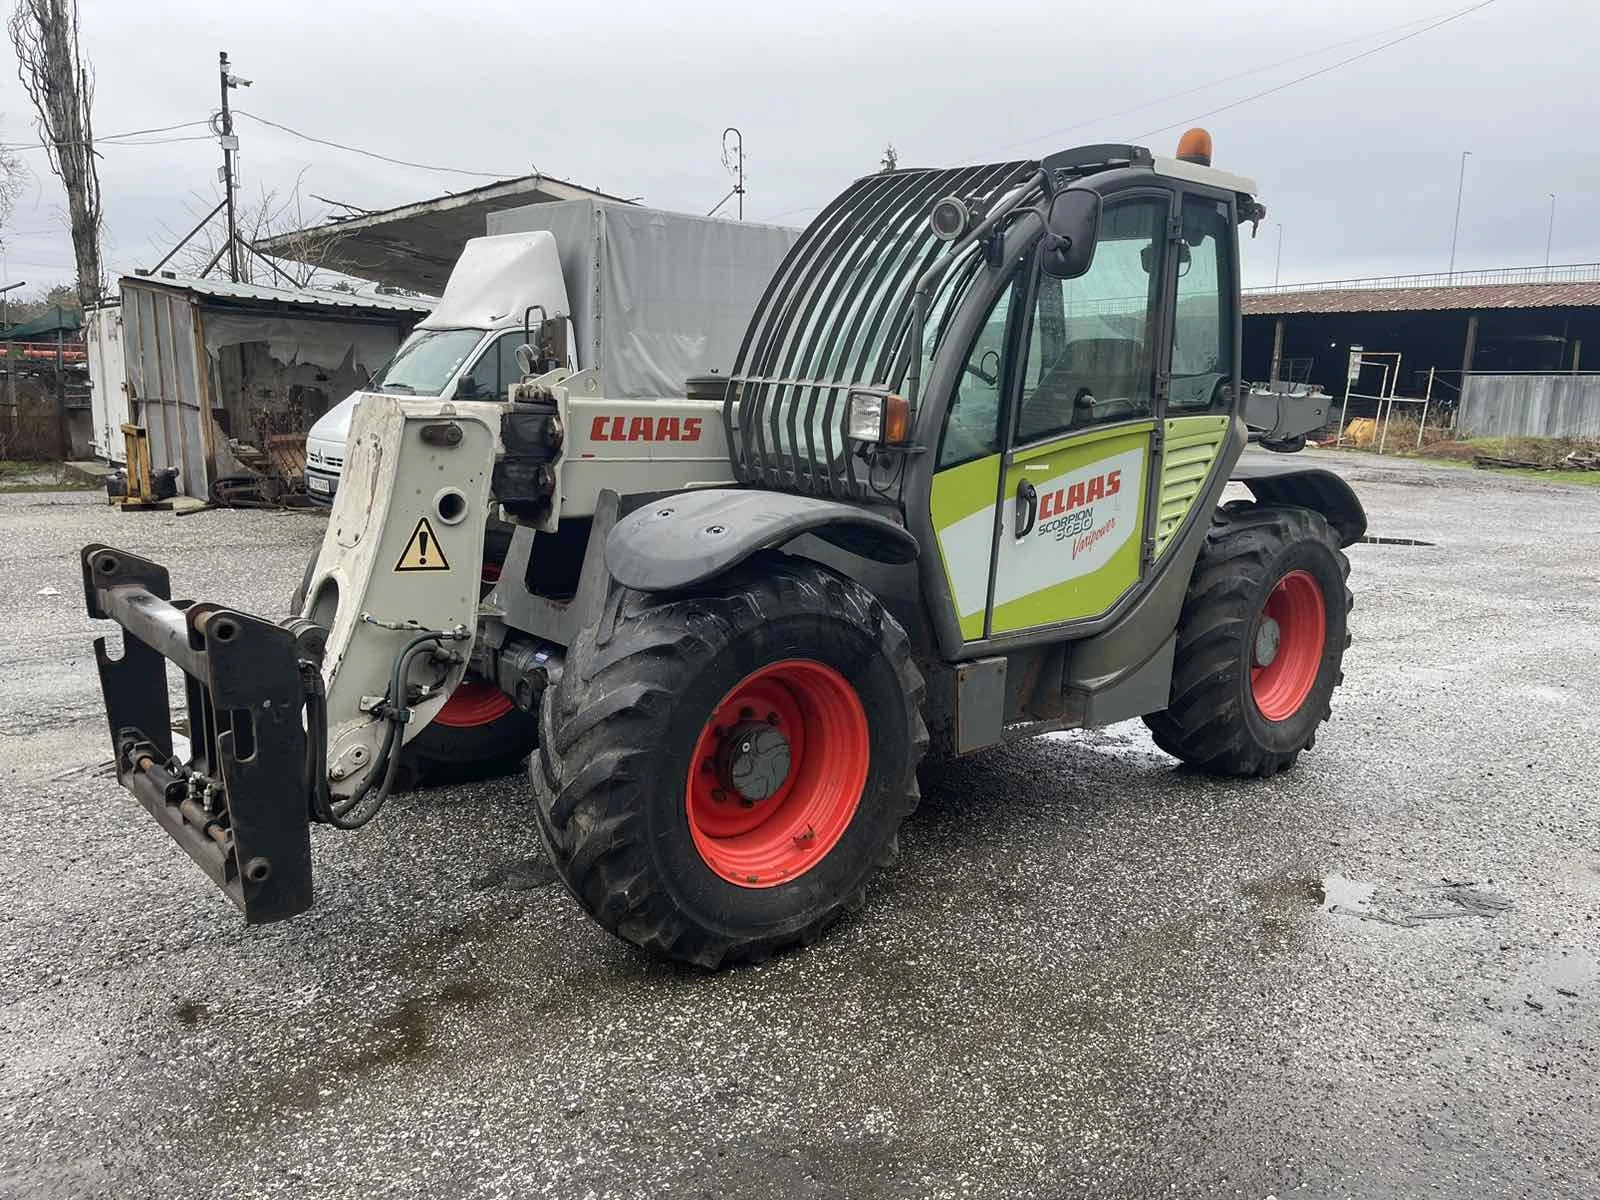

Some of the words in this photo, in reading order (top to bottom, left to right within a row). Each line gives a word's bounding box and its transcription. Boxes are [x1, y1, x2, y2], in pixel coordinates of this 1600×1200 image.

[590, 416, 702, 441] CLAAS
[1038, 470, 1121, 520] CLAAS
[1038, 507, 1093, 536] SCORPION
